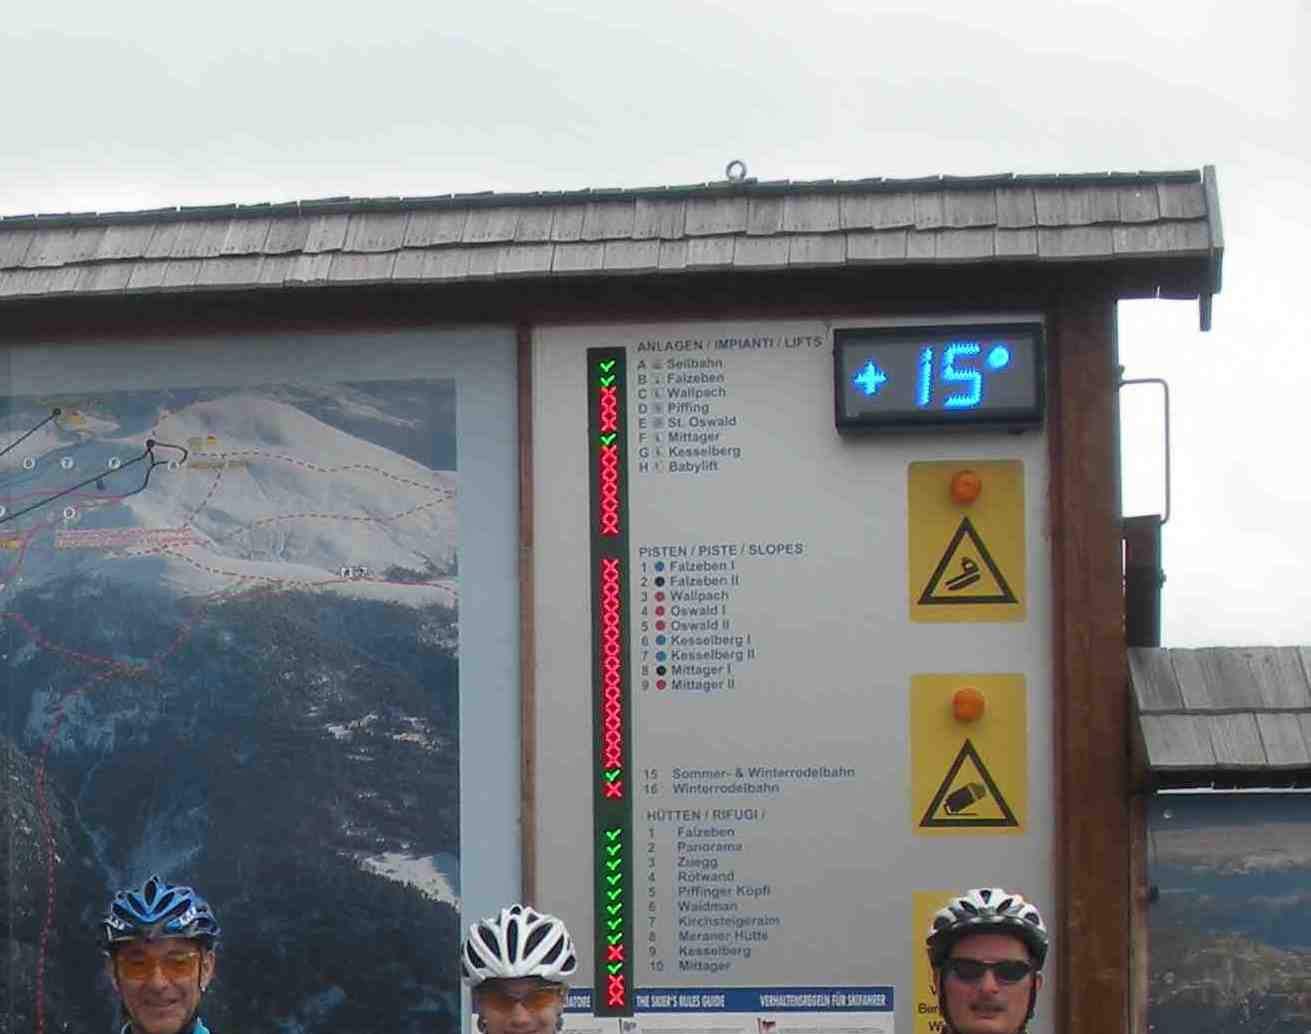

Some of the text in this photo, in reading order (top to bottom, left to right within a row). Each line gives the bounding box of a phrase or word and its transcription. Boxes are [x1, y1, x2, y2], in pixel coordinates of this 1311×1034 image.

[638, 340, 703, 351] ANLAGEN
[715, 338, 773, 350] IMPIANTI
[784, 336, 824, 348] LIFTS
[638, 359, 723, 370] A Seilbahn
[638, 373, 724, 385] B Falzeben
[638, 386, 726, 399] C Wallpach
[638, 402, 710, 416] D Piffing
[638, 418, 647, 428] E
[688, 416, 737, 428] Oswald
[639, 431, 720, 445] F Mittager
[638, 445, 741, 460] G Kesselberg
[639, 461, 719, 474] H Babylift
[639, 546, 687, 557] PISTEN
[698, 545, 738, 556] PISTE
[749, 543, 804, 555] SLOPES
[670, 561, 727, 572] Falzeben
[670, 575, 728, 586] Falzeben
[670, 590, 729, 602] Wallpach
[670, 605, 719, 616] Oswald
[670, 619, 719, 631] Oswald
[670, 634, 743, 647] Kesselberg
[671, 649, 744, 662] Kesselberg
[671, 664, 725, 677] Mittager
[672, 679, 725, 692] Mittager
[749, 767, 855, 778] Winterrodelbahn
[672, 783, 780, 794] Winterrodelbahn
[713, 808, 758, 820] RIFUGI
[677, 826, 735, 838] Falzeben
[677, 841, 742, 852] Panorama
[677, 856, 718, 870] Zuegg
[678, 870, 734, 881] Rotwand
[678, 886, 732, 899] Piffinger
[679, 931, 730, 942] Meraner
[679, 945, 752, 959] Kesselberg
[679, 960, 731, 973] Mittager
